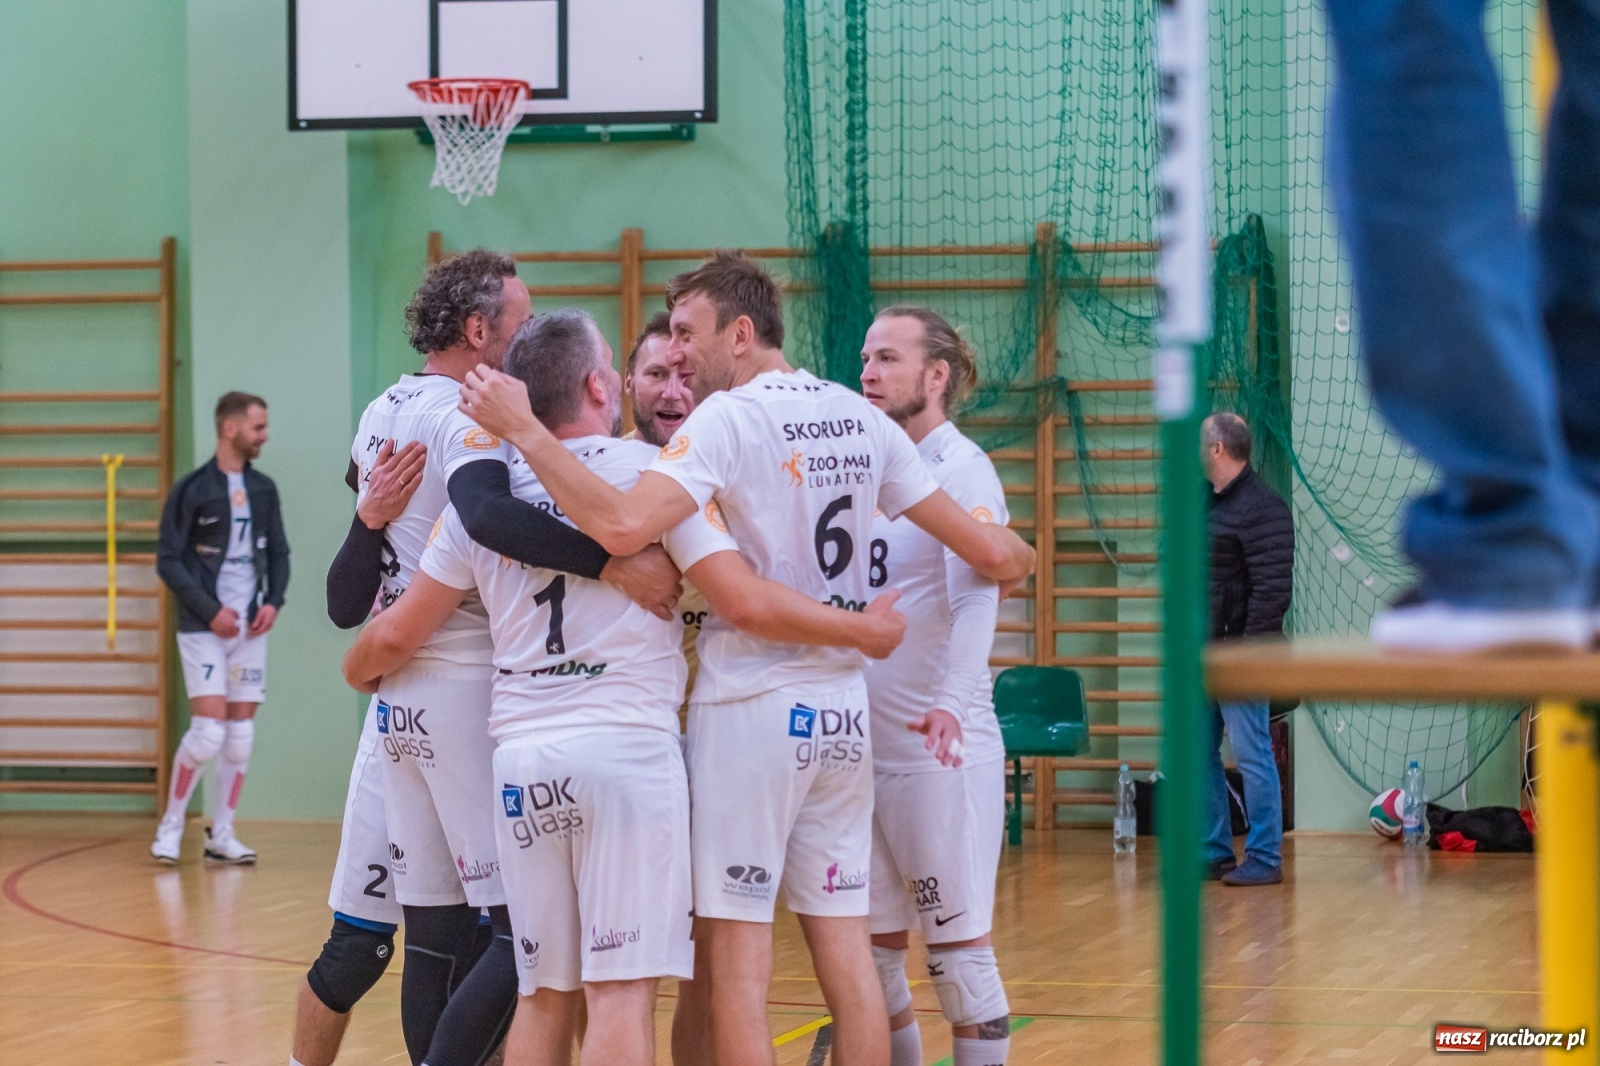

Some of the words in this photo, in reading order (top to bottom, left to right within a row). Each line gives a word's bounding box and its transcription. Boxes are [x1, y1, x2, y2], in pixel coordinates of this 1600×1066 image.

[782, 418, 867, 441] SKORUPA
[235, 518, 251, 543] 7
[814, 494, 853, 581] 6
[869, 538, 889, 588] 8
[533, 574, 566, 655] 1
[202, 664, 216, 681] 7
[392, 705, 430, 736] DK
[820, 708, 864, 738] DK
[384, 729, 434, 763] glass
[796, 734, 863, 770] glass
[528, 776, 577, 811] DK
[513, 808, 583, 849] glass
[363, 863, 389, 900] 2
